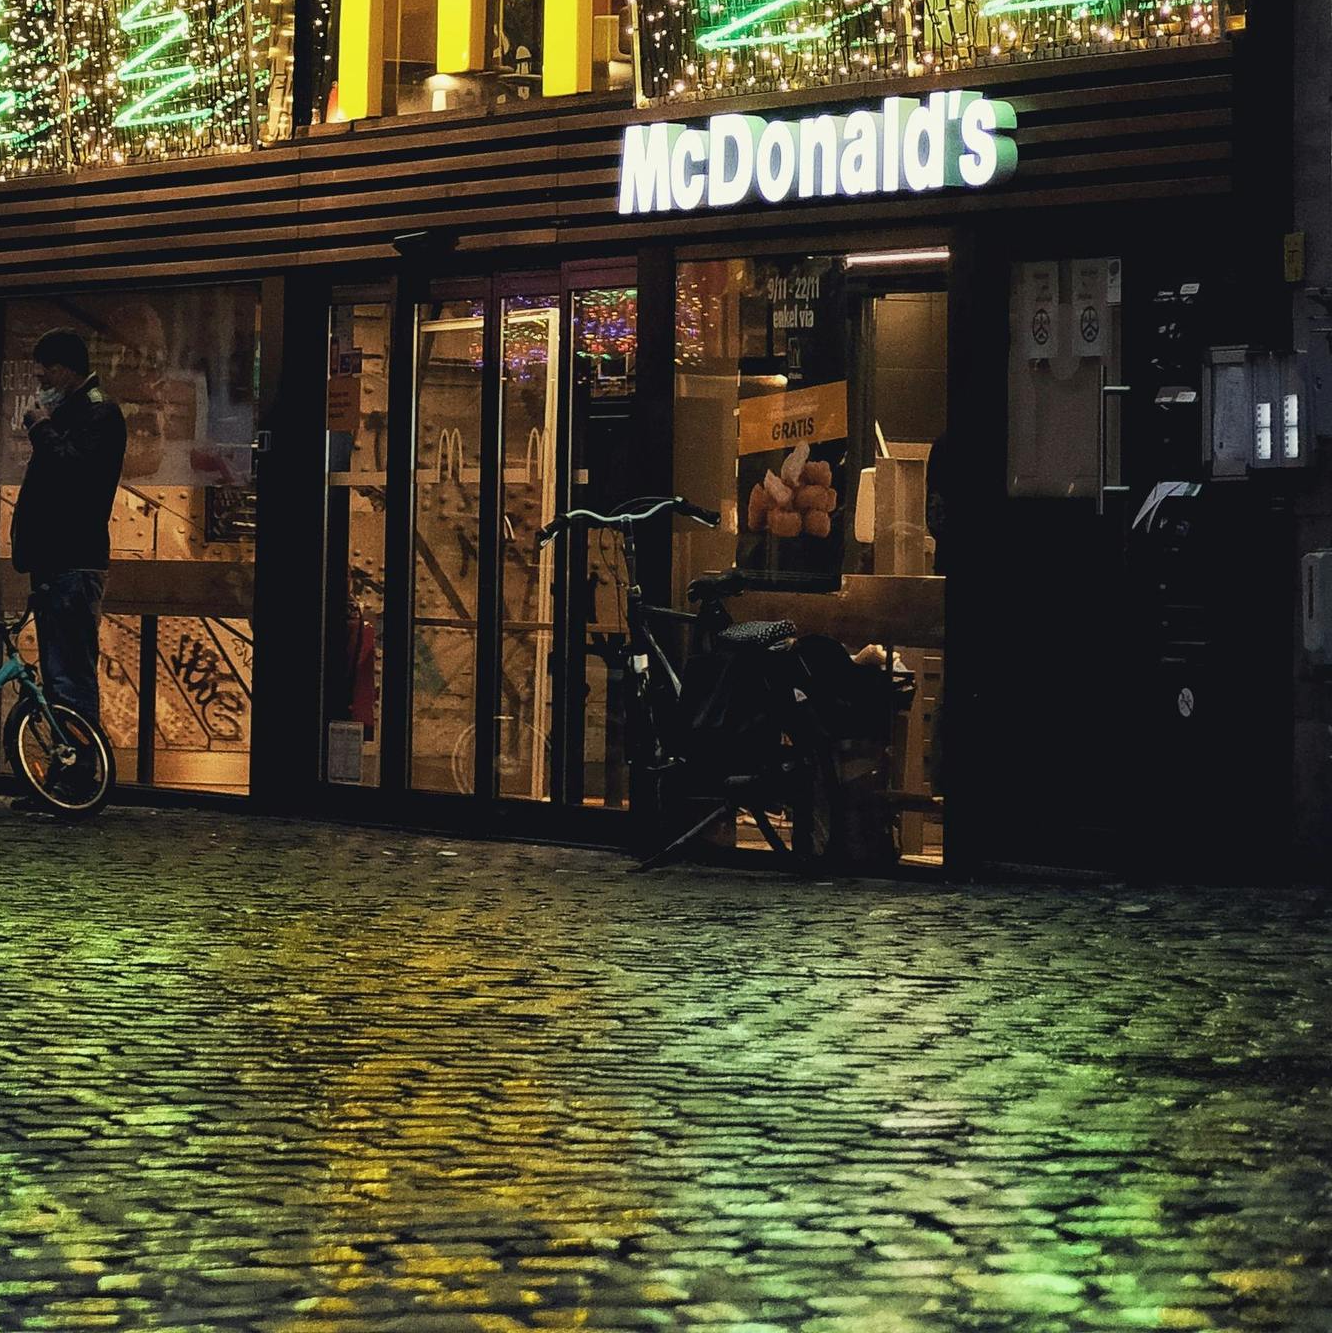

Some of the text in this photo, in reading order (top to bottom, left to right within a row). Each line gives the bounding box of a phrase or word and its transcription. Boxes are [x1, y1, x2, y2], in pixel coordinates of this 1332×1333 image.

[617, 89, 1019, 216] McDonald's
[767, 276, 787, 304] 9/11
[794, 276, 820, 302] 22/11
[772, 304, 815, 329] enkel via
[771, 417, 815, 441] GRATIS
